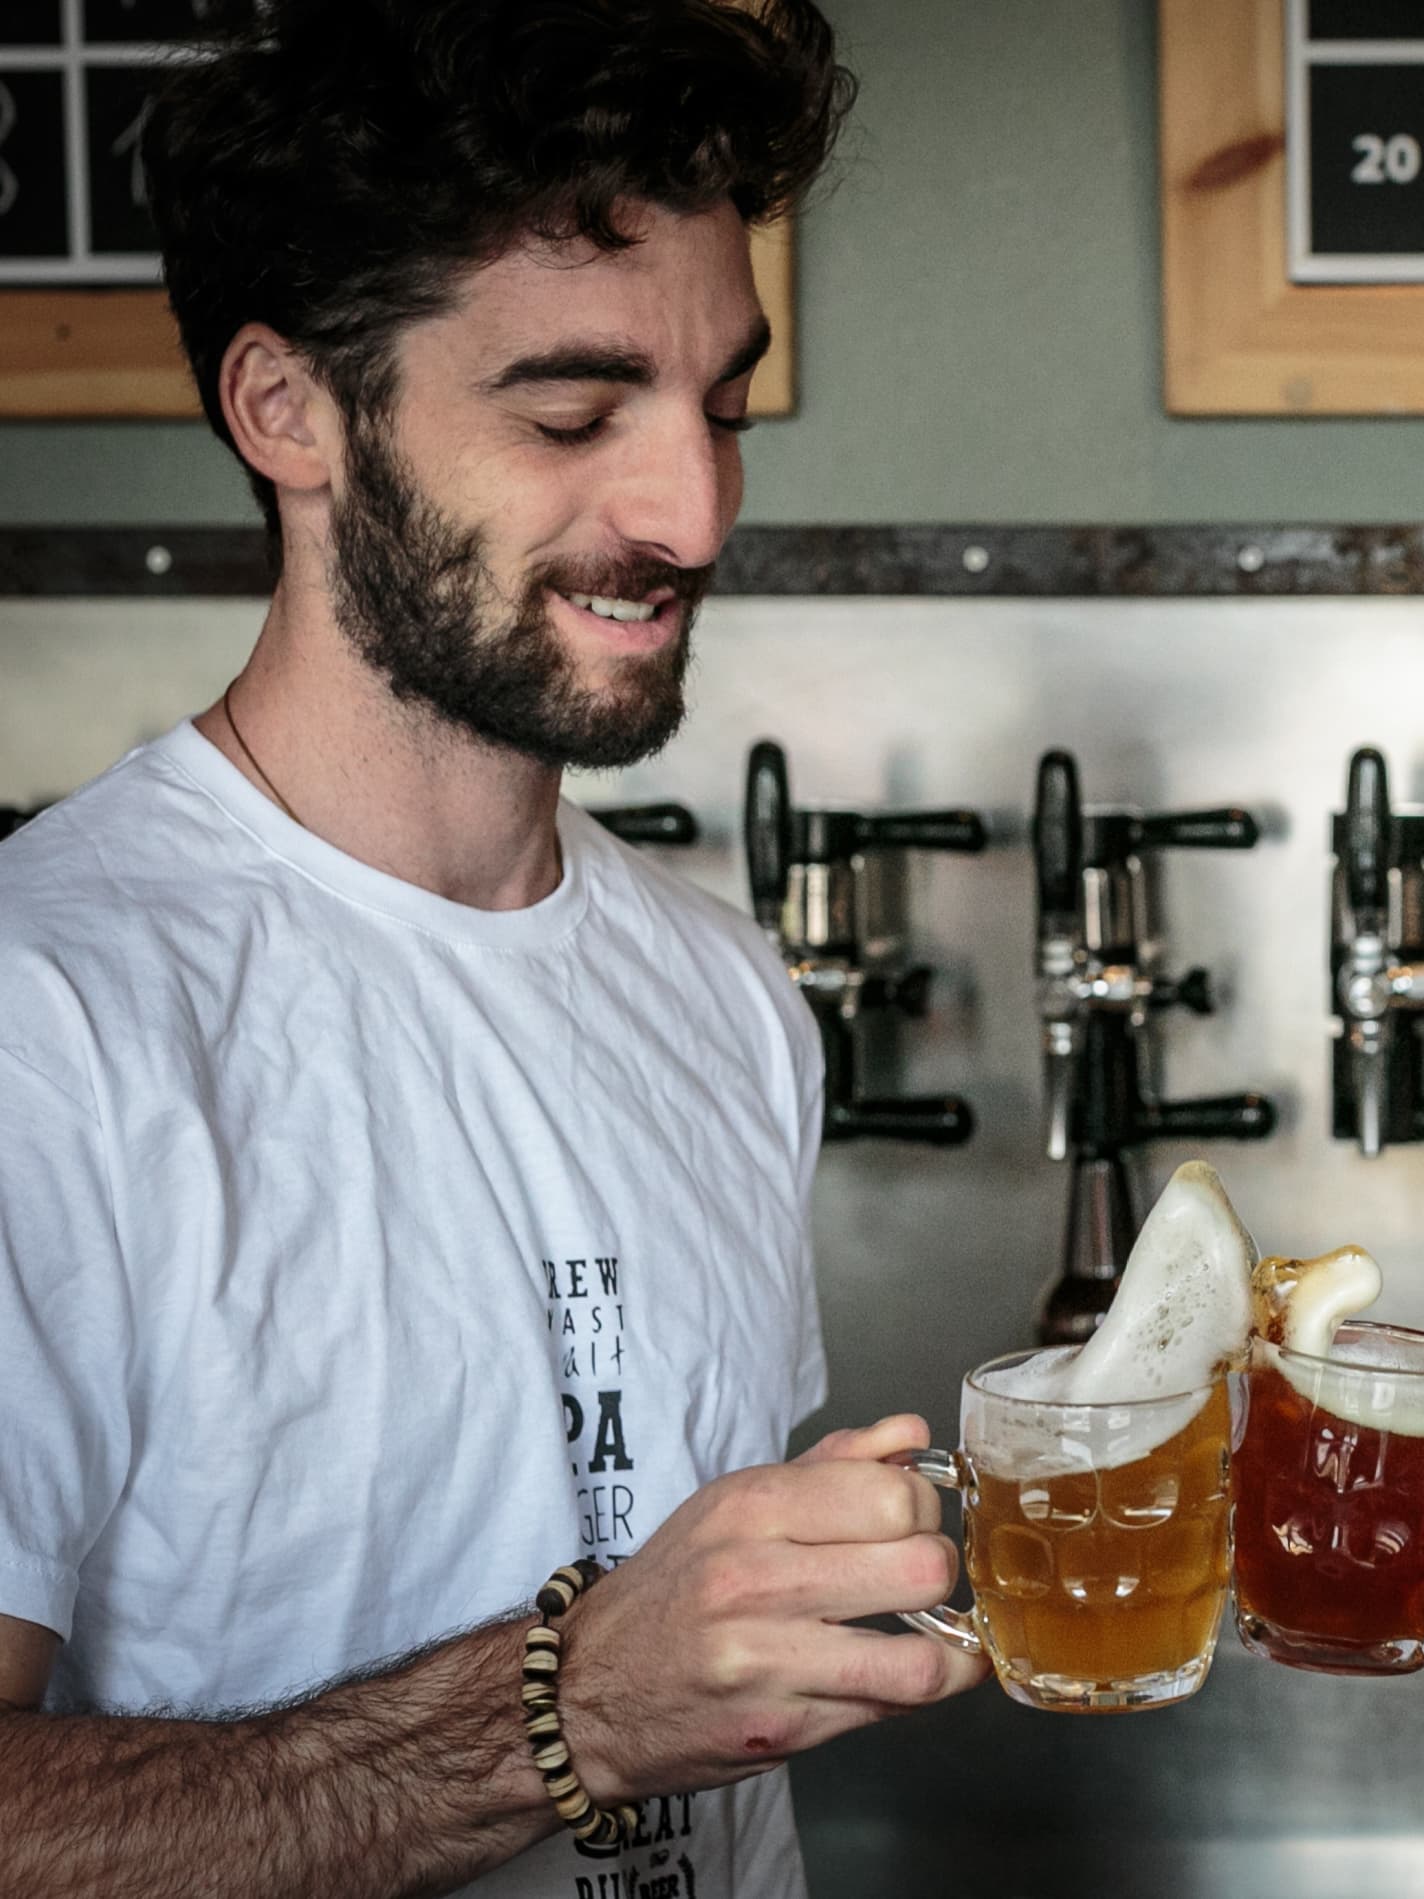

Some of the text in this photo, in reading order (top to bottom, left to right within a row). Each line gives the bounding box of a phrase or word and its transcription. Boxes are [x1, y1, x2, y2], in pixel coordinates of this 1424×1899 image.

[1351, 132, 1421, 184] 20
[543, 1257, 619, 1299] REW
[548, 1305, 624, 1335] AST
